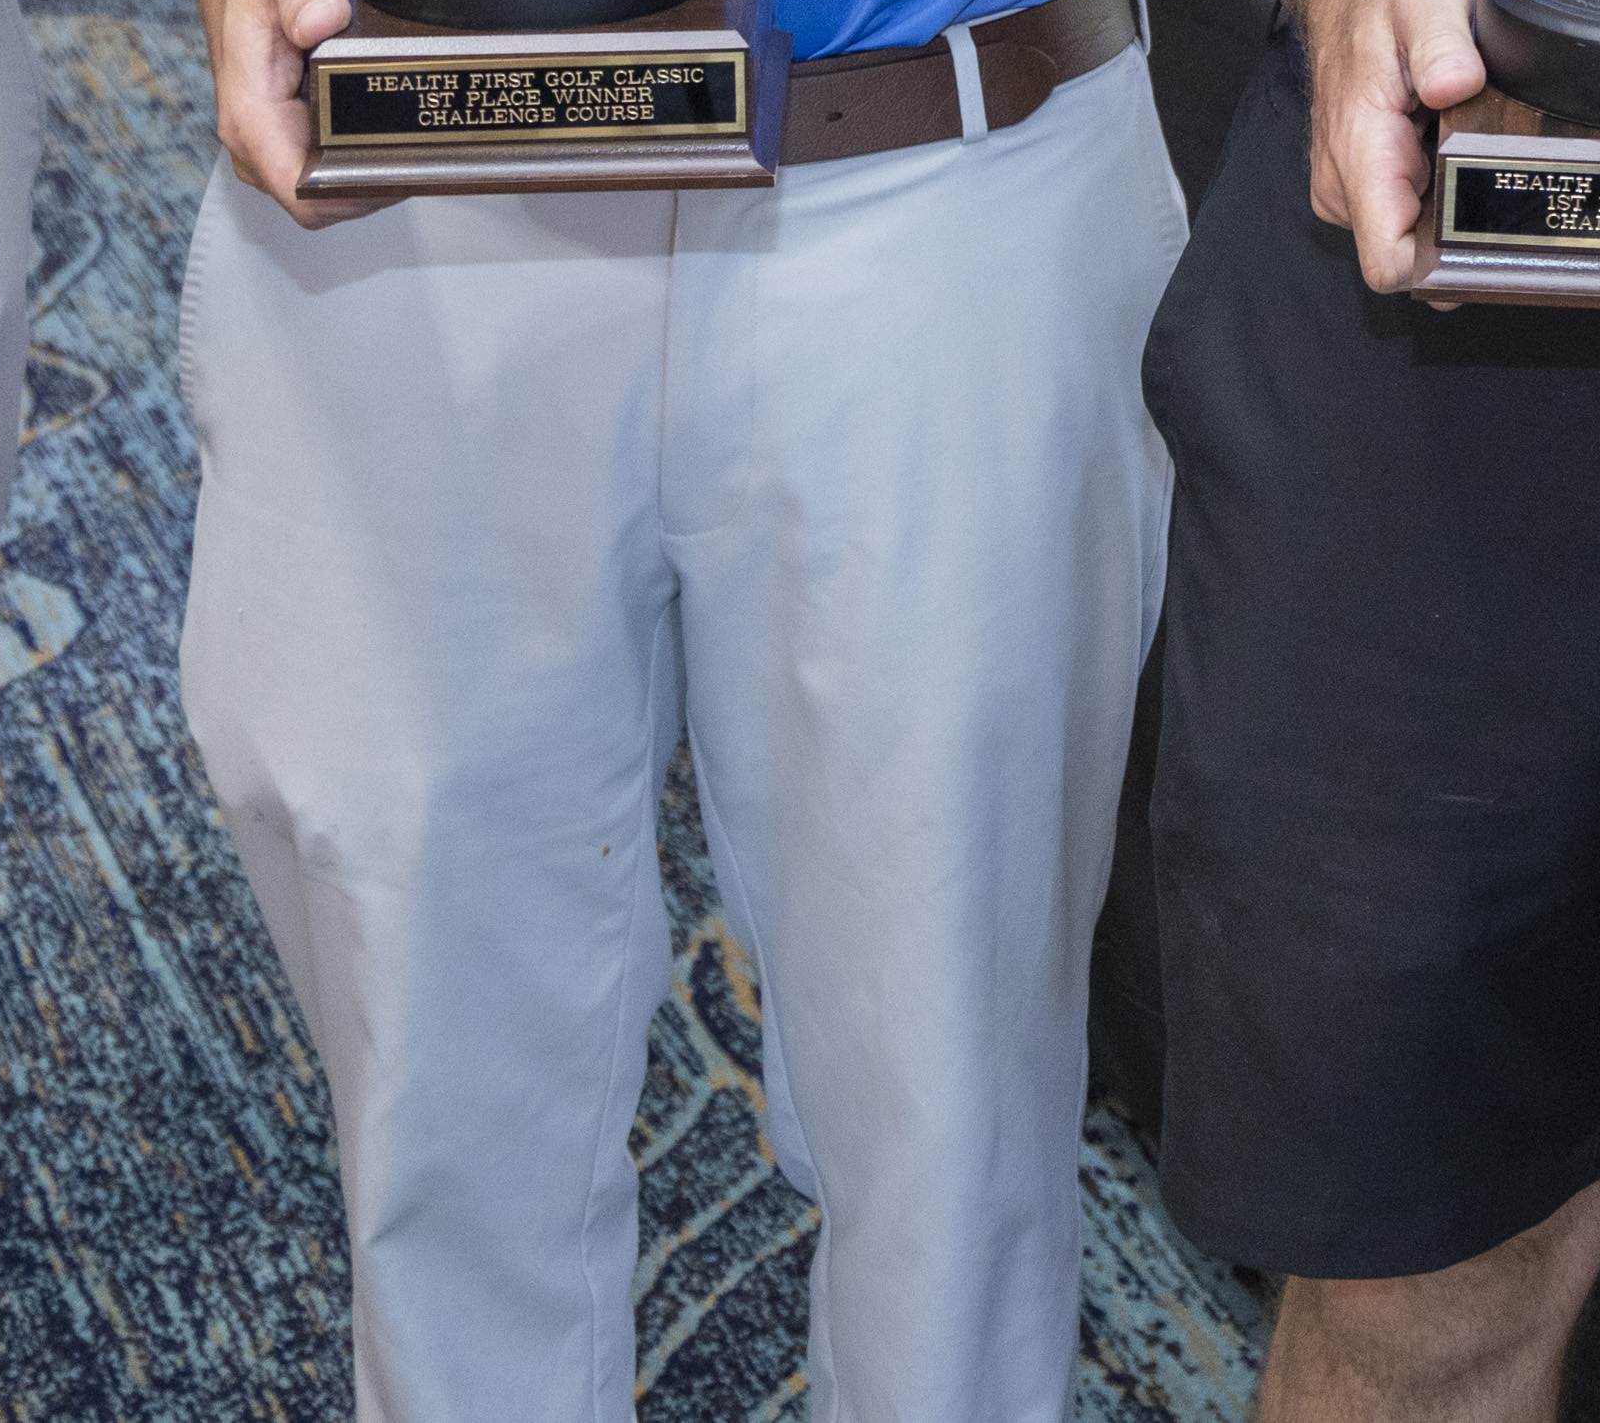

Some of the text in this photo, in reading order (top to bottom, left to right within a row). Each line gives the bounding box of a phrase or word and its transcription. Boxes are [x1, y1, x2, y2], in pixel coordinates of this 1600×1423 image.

[367, 67, 705, 93] HEALTH FIRST GOLF CLASSIC
[418, 86, 654, 110] 1ST PLACE WINNER
[418, 104, 655, 127] CHALLENGE COURSE
[1495, 172, 1593, 194] HEALTH
[1547, 194, 1587, 213] 1ST
